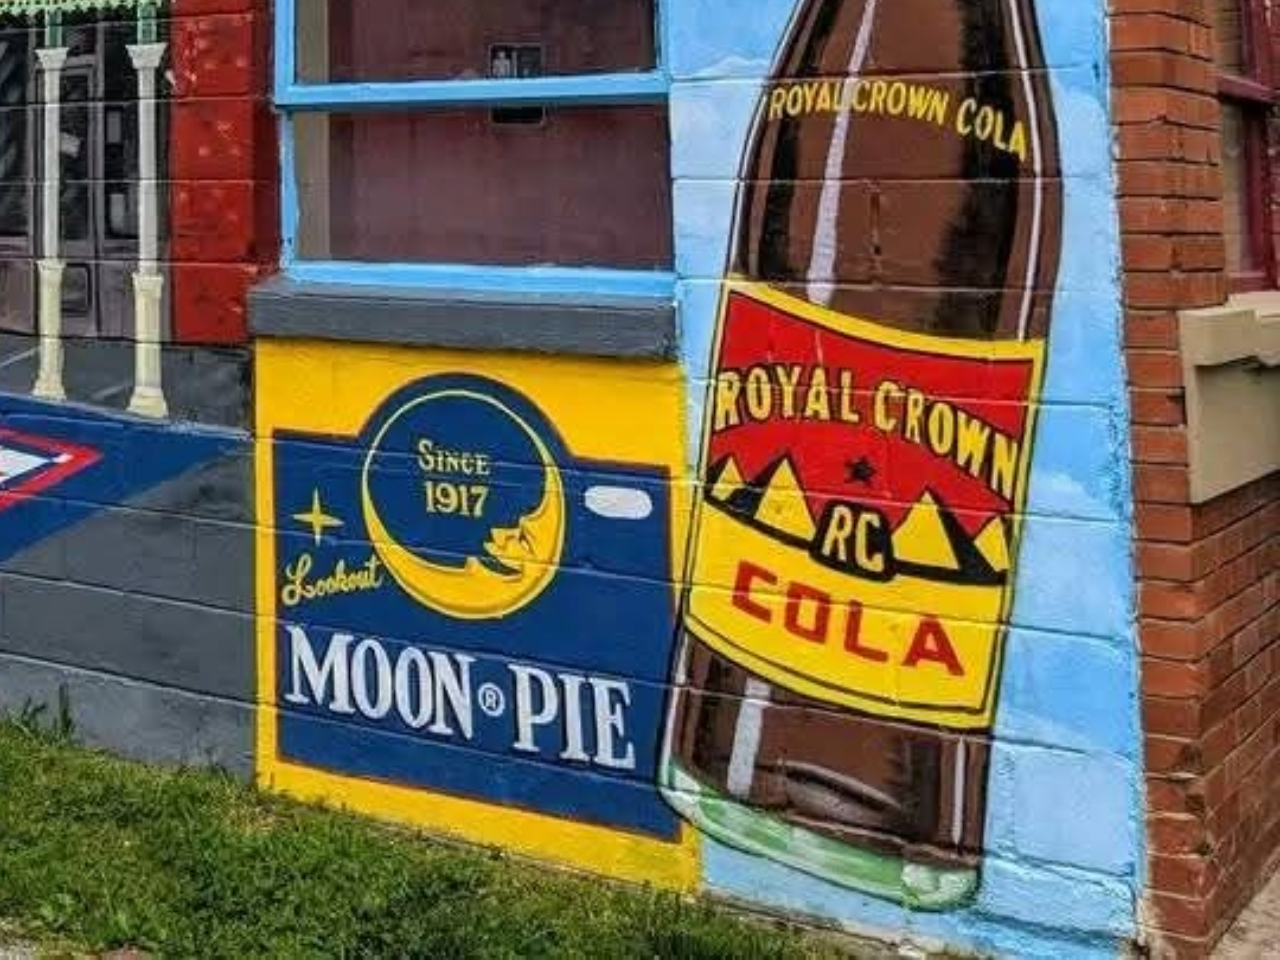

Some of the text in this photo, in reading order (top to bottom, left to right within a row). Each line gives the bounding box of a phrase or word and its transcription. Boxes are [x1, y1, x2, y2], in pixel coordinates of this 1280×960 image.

[768, 79, 1027, 163] ROYAL CROWN COLA
[417, 438, 490, 477] SINCE
[713, 364, 1020, 500] ROYAL CROWN
[424, 480, 489, 518] 1917
[821, 503, 886, 573] RC
[281, 553, 385, 606] Lookout
[730, 559, 966, 677] COLA
[284, 624, 477, 740] MOON
[508, 661, 637, 771] PIE
